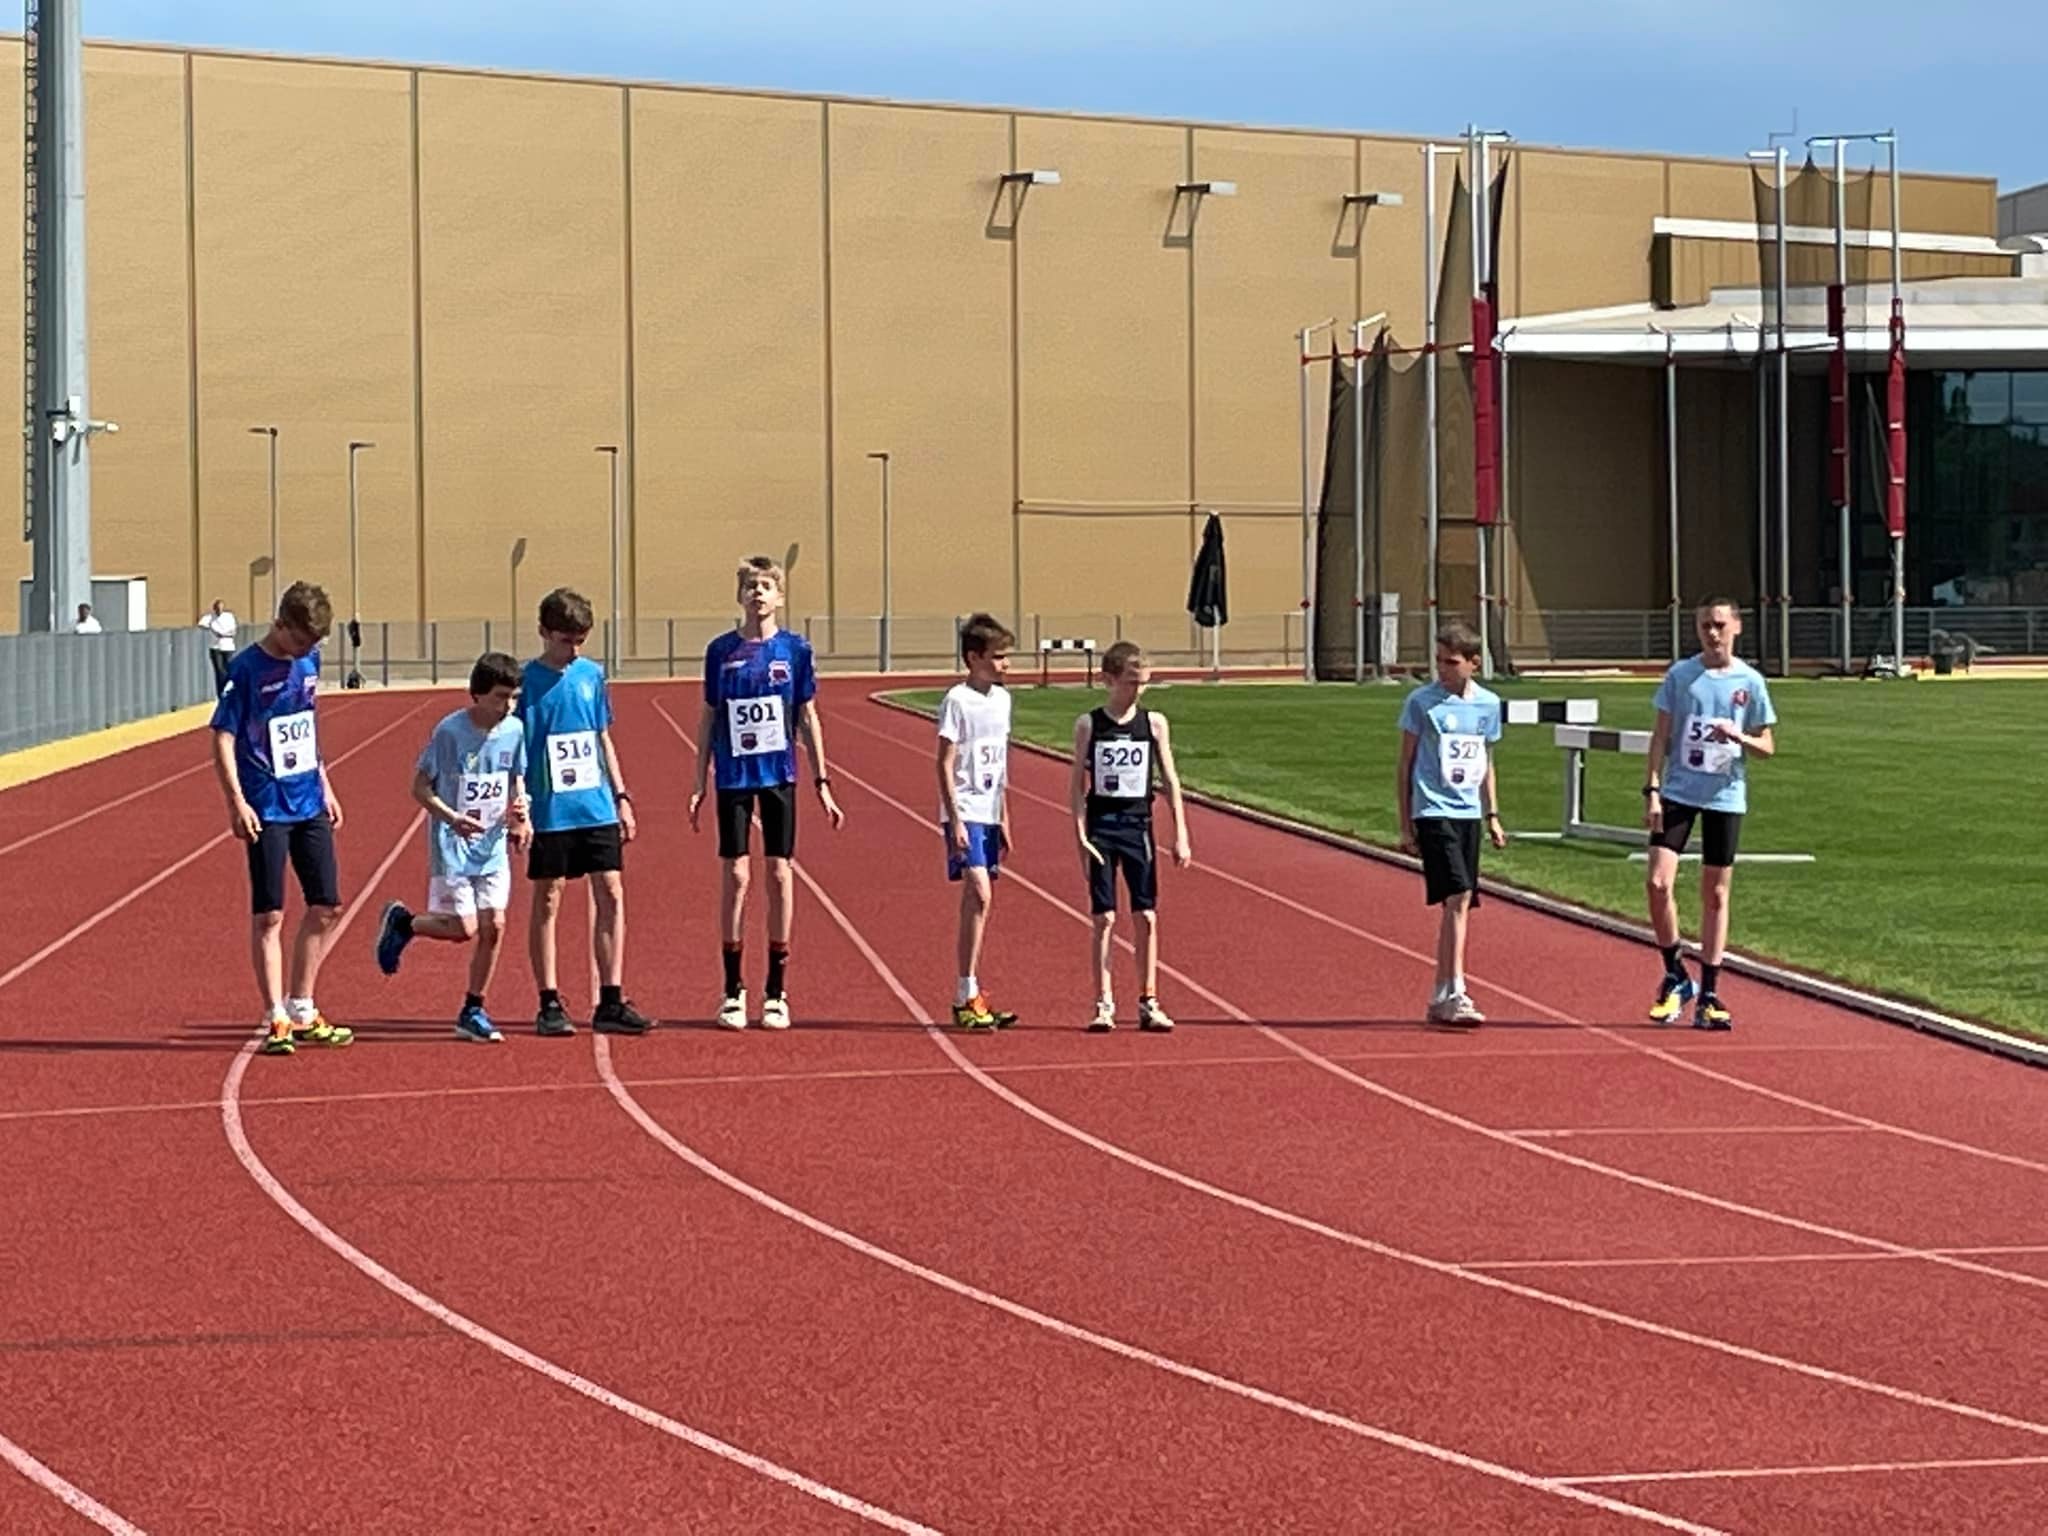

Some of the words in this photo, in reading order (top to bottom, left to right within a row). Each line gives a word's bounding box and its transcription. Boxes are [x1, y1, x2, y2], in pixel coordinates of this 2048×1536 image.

[736, 703, 777, 725] 501
[277, 719, 310, 744] 502
[1689, 722, 1729, 744] 52
[1102, 747, 1143, 766] 520
[466, 780, 502, 801] 526
